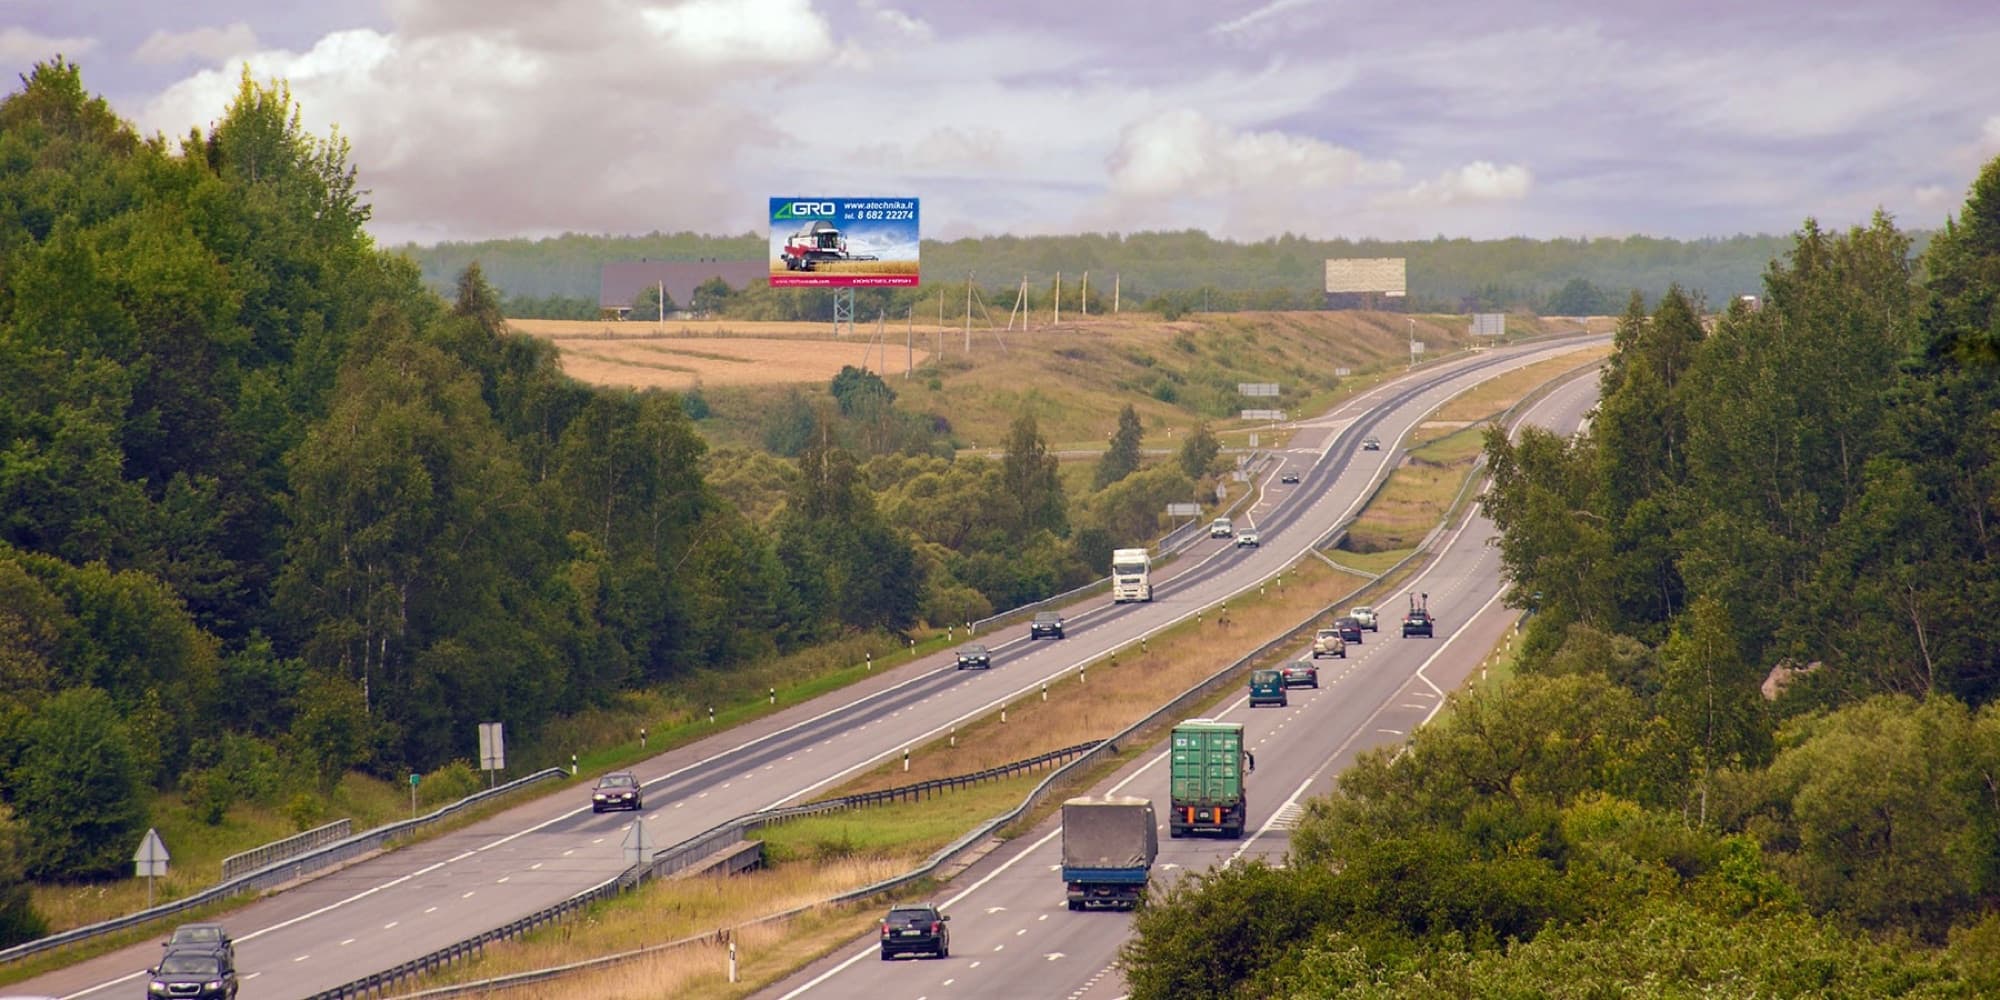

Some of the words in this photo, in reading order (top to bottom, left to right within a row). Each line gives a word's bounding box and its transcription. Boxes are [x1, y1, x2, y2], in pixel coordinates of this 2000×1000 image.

[844, 202, 913, 210] www.atechnika.lt
[858, 210, 864, 219] 8
[866, 210, 883, 219] 682
[886, 210, 913, 219] 22274
